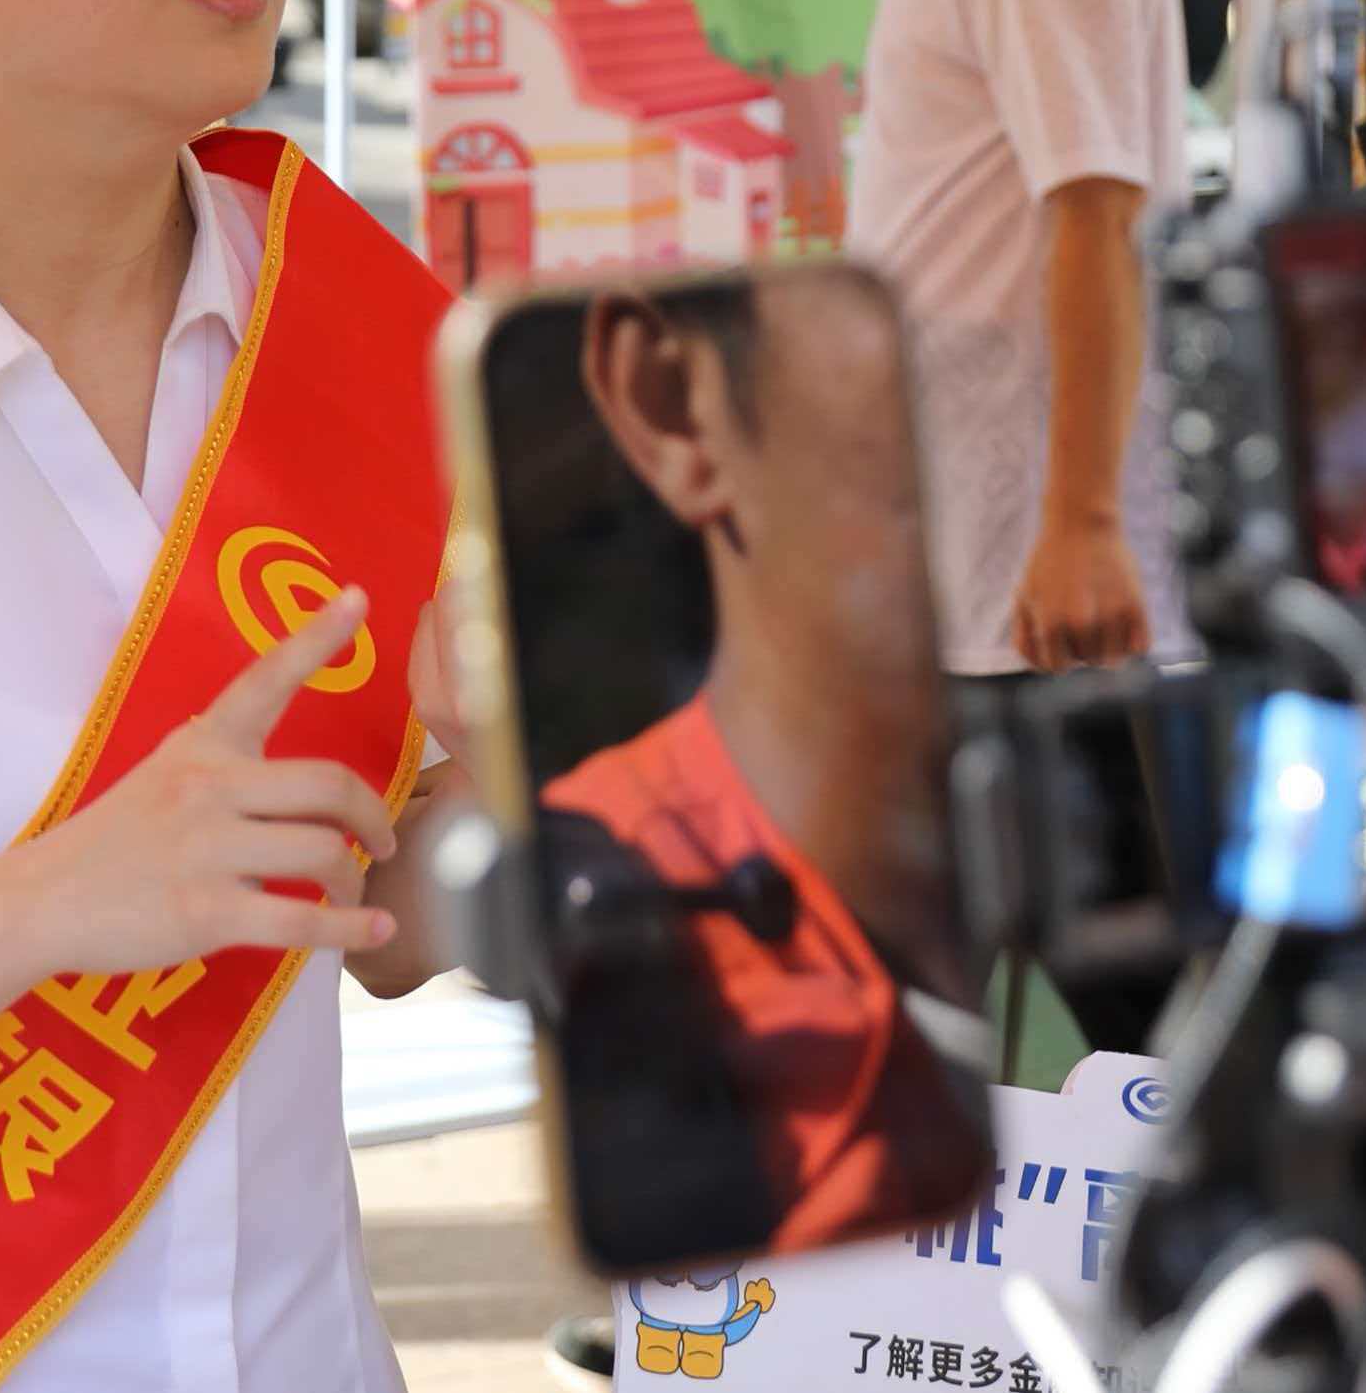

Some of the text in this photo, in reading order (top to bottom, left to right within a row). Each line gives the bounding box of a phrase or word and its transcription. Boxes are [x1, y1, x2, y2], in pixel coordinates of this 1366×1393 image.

[848, 1330, 1123, 1393] 了解更多金
